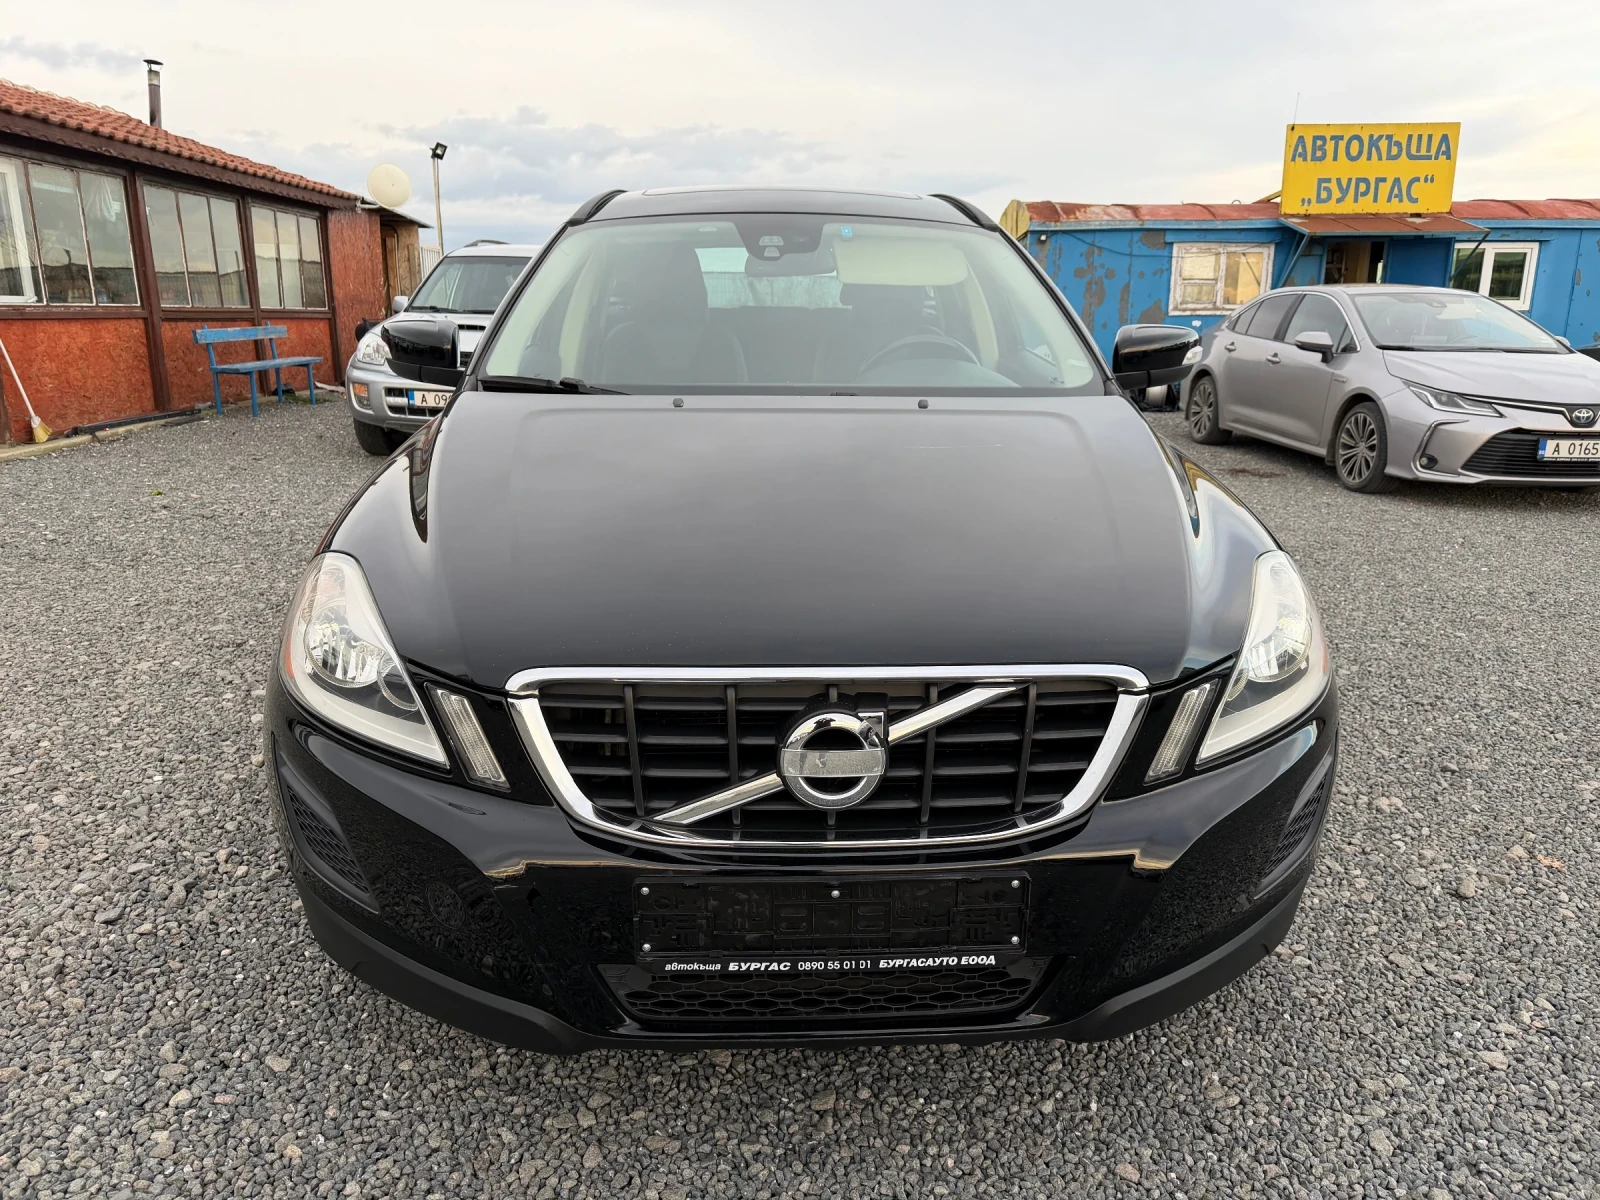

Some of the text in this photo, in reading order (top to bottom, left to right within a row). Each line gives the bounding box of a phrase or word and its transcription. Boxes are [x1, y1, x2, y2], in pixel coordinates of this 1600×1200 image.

[421, 394, 427, 404] A
[1552, 442, 1559, 455] A
[1568, 443, 1599, 455] 0165
[728, 962, 791, 971] БУРГАС
[827, 961, 840, 969] 55
[879, 957, 957, 968] БУРГАСАУТО
[961, 955, 996, 965] ЕООД
